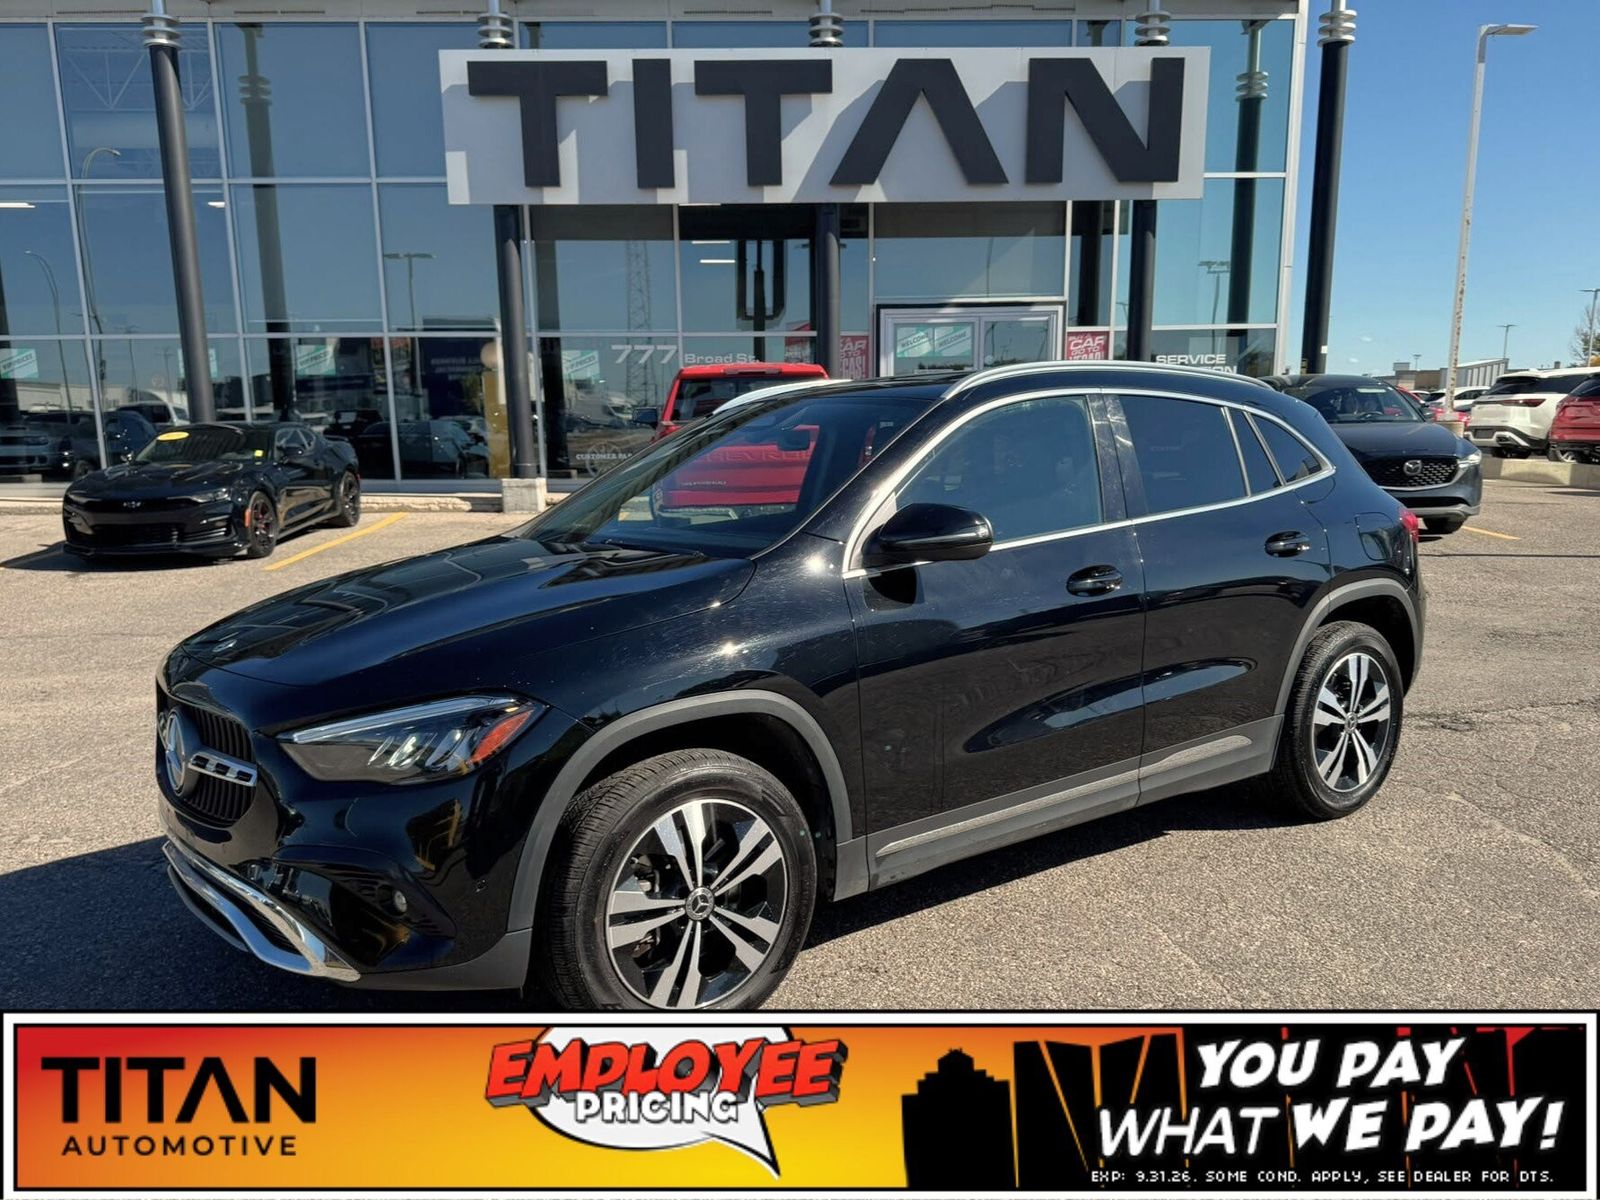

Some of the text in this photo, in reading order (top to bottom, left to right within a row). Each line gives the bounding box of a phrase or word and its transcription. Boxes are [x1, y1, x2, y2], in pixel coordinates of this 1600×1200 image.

[467, 58, 1185, 188] TITAN
[611, 344, 678, 364] 777
[684, 353, 733, 364] Broad
[1155, 353, 1227, 365] SERVICE
